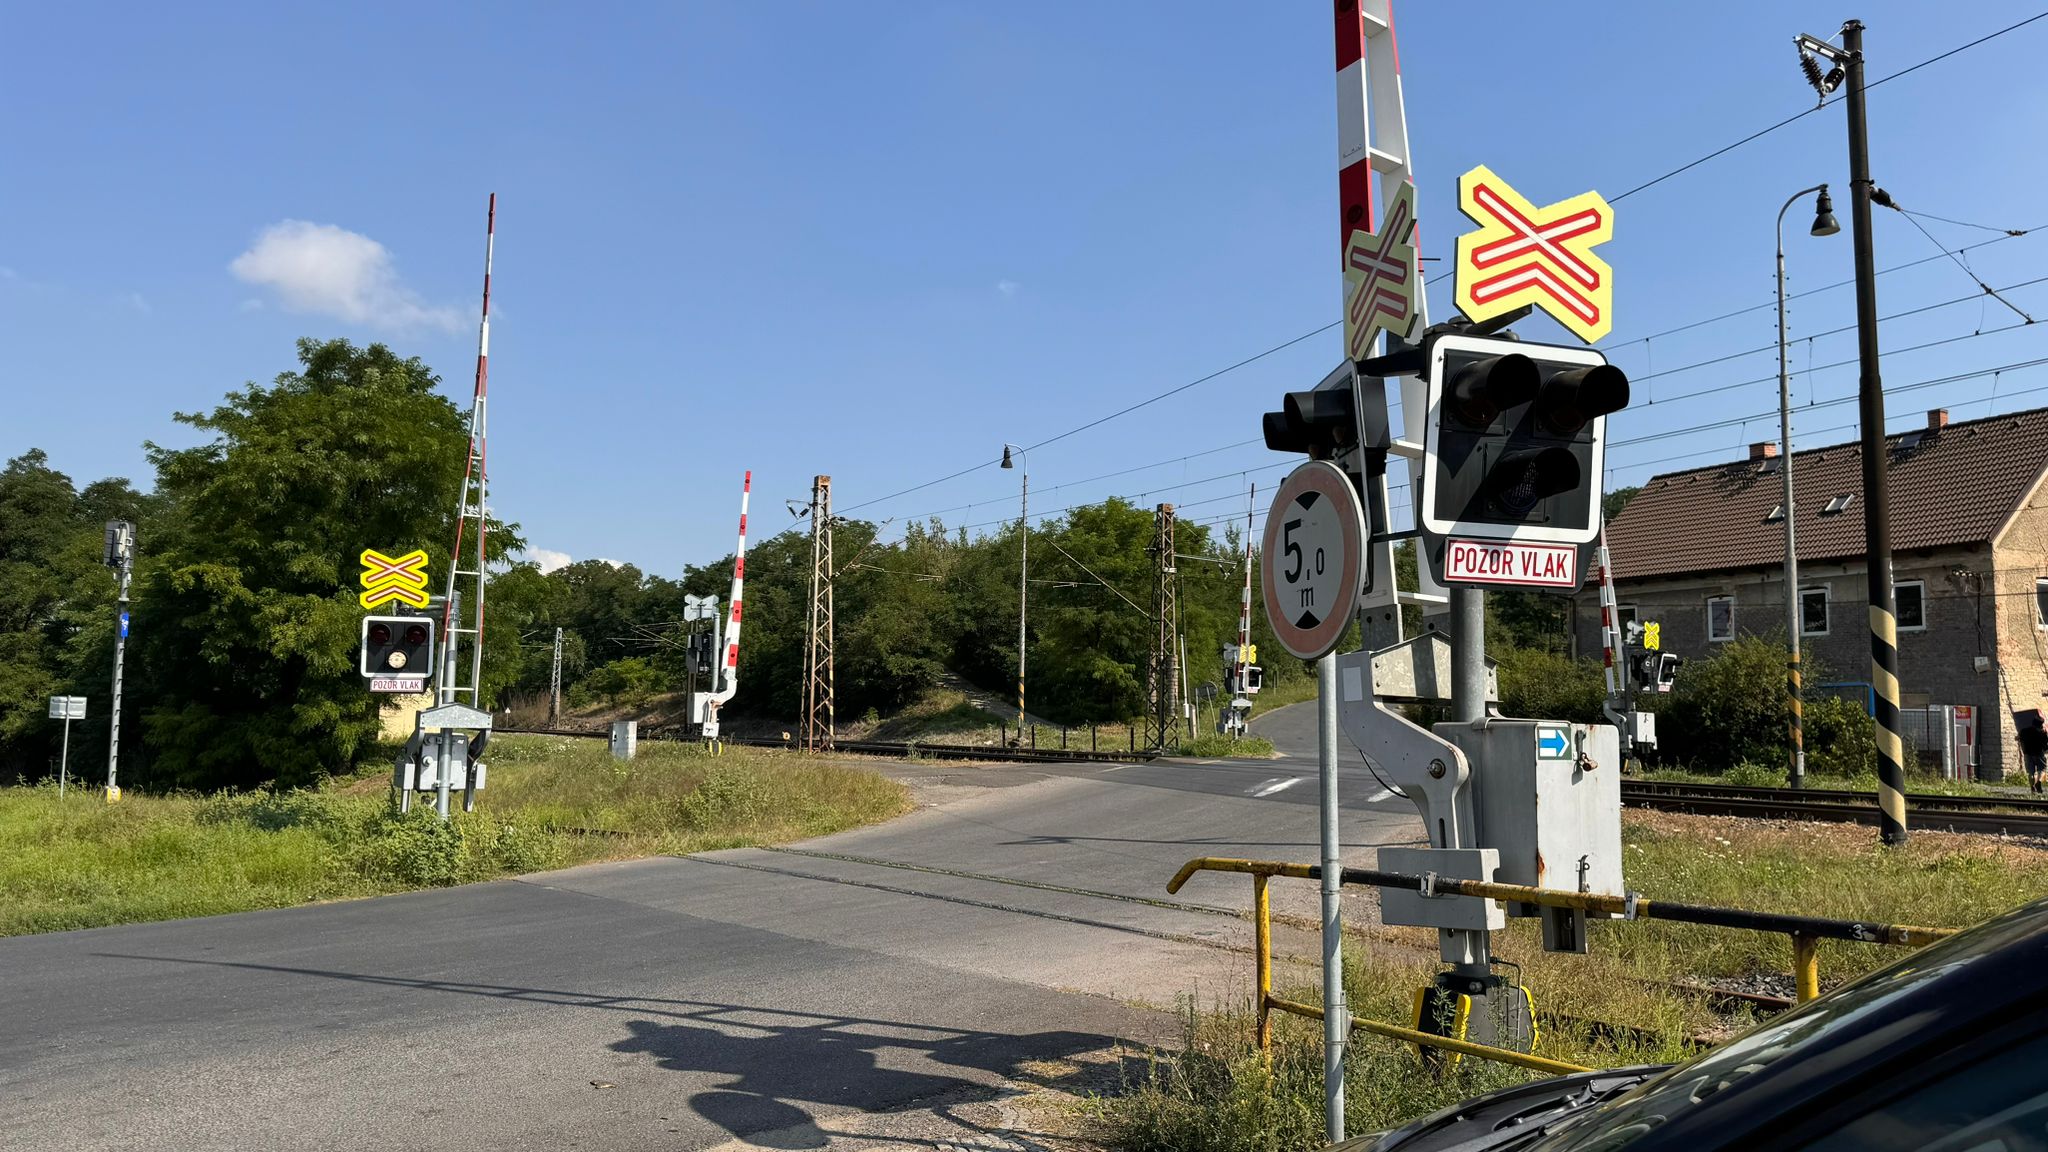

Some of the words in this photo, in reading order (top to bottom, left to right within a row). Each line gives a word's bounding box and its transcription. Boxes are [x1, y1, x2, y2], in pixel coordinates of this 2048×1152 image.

[1453, 546, 1514, 575] POZOR
[1521, 550, 1568, 579] VLAK
[1300, 586, 1315, 608] m
[373, 681, 397, 689] POZOR
[400, 681, 419, 689] VLAK
